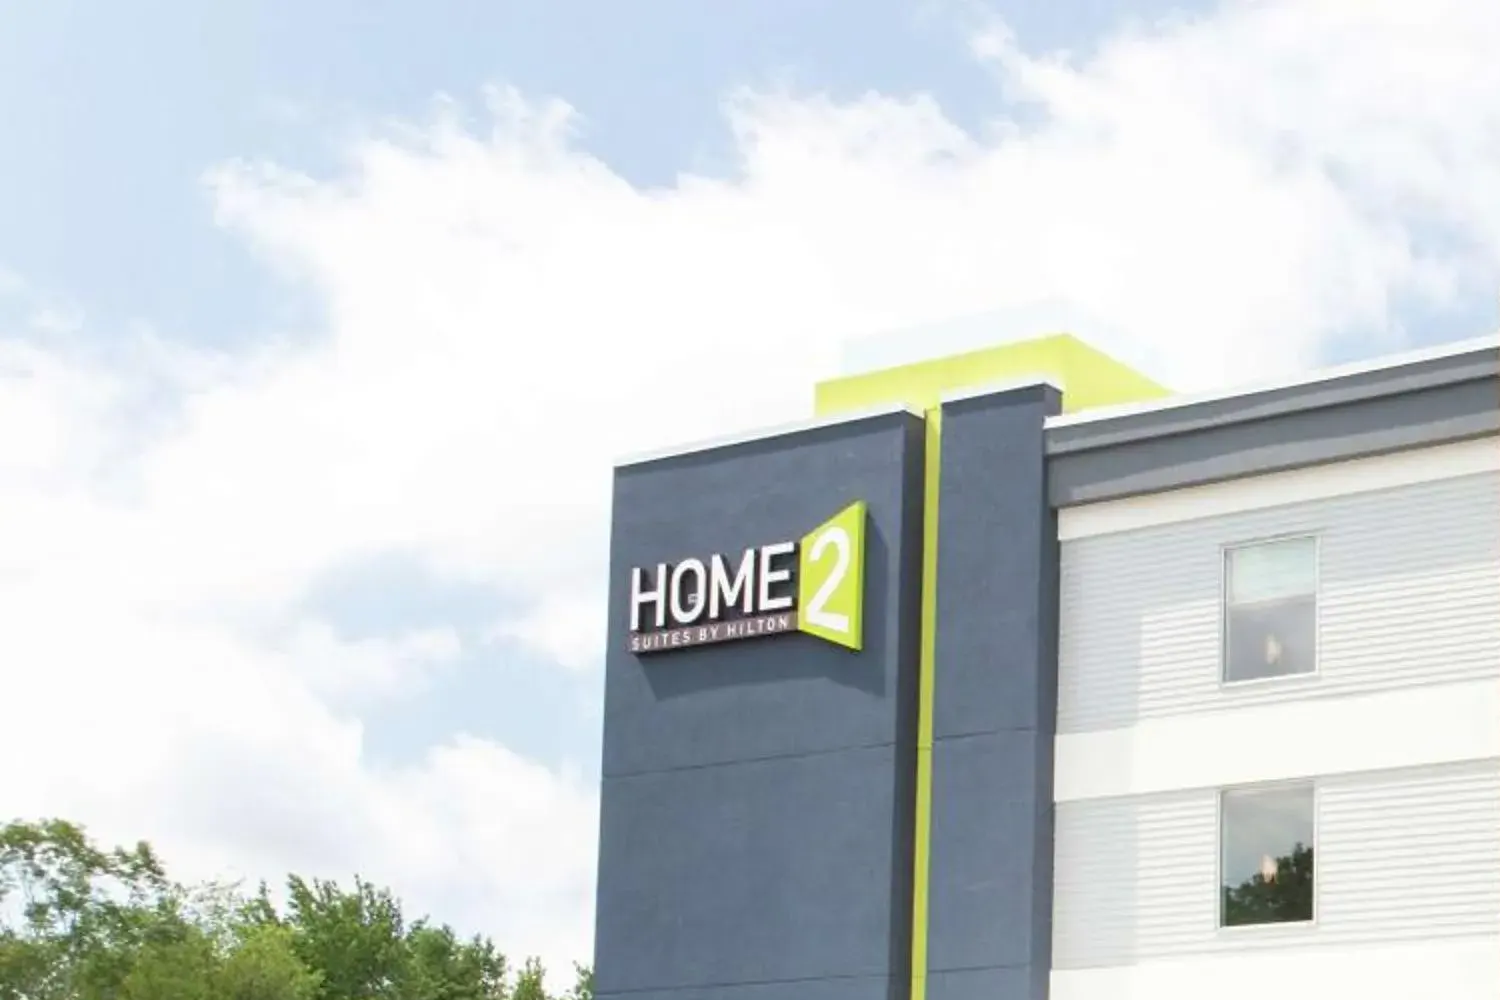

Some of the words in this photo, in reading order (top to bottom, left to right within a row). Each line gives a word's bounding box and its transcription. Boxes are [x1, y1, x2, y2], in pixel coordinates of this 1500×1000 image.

[630, 541, 795, 631] HOME
[805, 526, 851, 633] 2
[631, 629, 691, 652] SUITES
[699, 624, 720, 642] BY
[726, 614, 789, 638] HILTON
